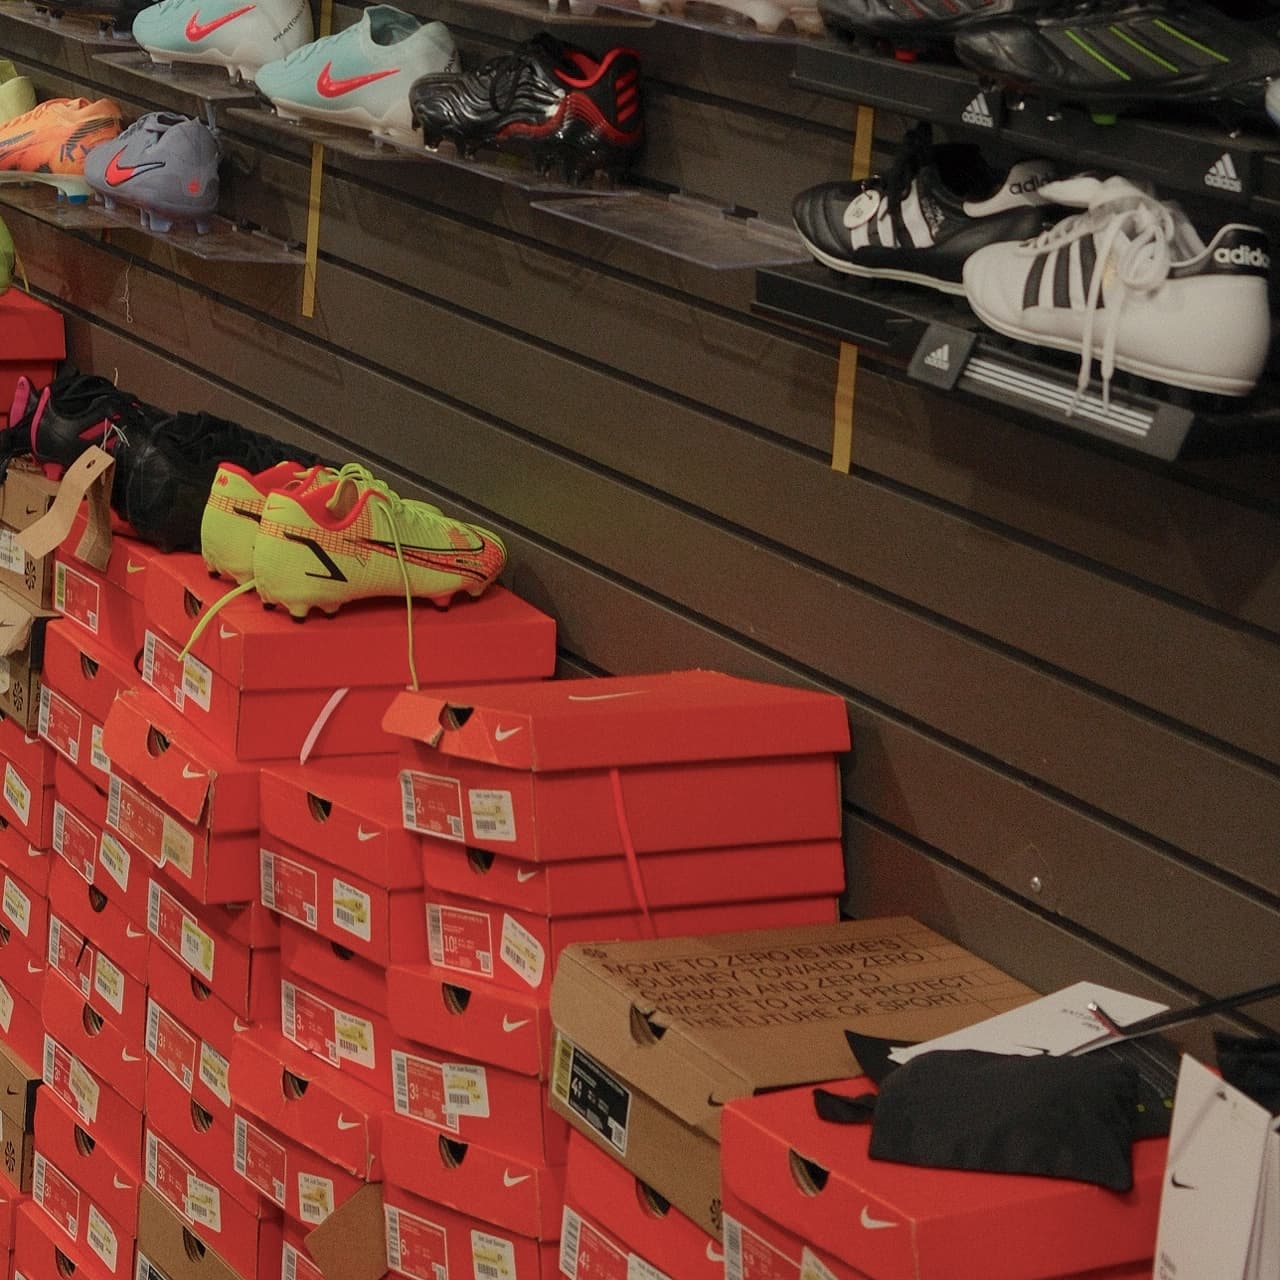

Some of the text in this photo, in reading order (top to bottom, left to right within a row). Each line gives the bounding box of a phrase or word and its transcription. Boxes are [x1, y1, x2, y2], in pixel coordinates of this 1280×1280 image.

[961, 111, 994, 129] adidas
[602, 938, 902, 977] MOVE TO ZERO IS NIKE'S
[626, 952, 925, 989] JOURNEY TOWARD ZERO
[640, 972, 881, 1003] CARBON AND ZERO
[655, 974, 974, 1017] WASTE TO HELP PROTECT
[735, 1006, 834, 1028] FUTURE
[838, 1004, 869, 1017] OF
[876, 991, 968, 1012] SPORT.
